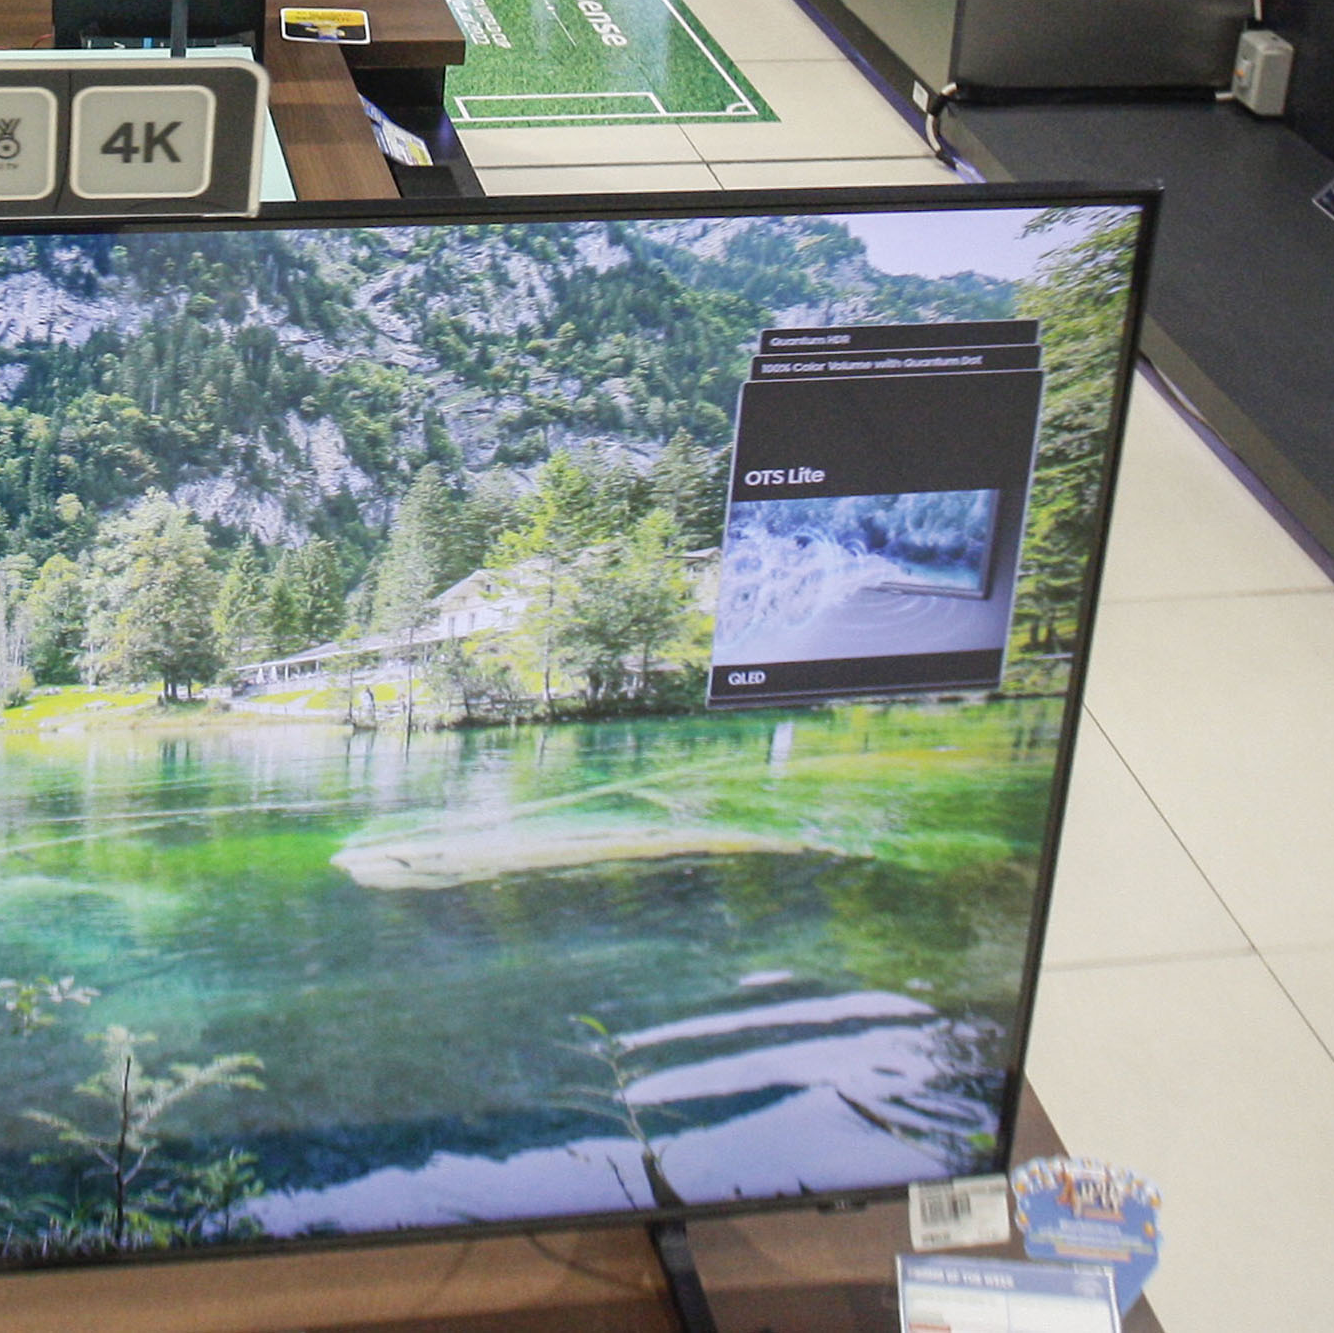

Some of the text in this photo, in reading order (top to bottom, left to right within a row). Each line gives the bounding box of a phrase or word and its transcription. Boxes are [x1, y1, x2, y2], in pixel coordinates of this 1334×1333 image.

[100, 120, 182, 164] 4K
[769, 336, 825, 348] Quantum
[793, 361, 826, 372] Color
[827, 359, 872, 371] Volume
[873, 358, 904, 370] with
[905, 356, 961, 368] Quantum
[962, 355, 984, 366] Dot
[744, 466, 827, 487] OTS Lite
[728, 670, 766, 686] QLED
